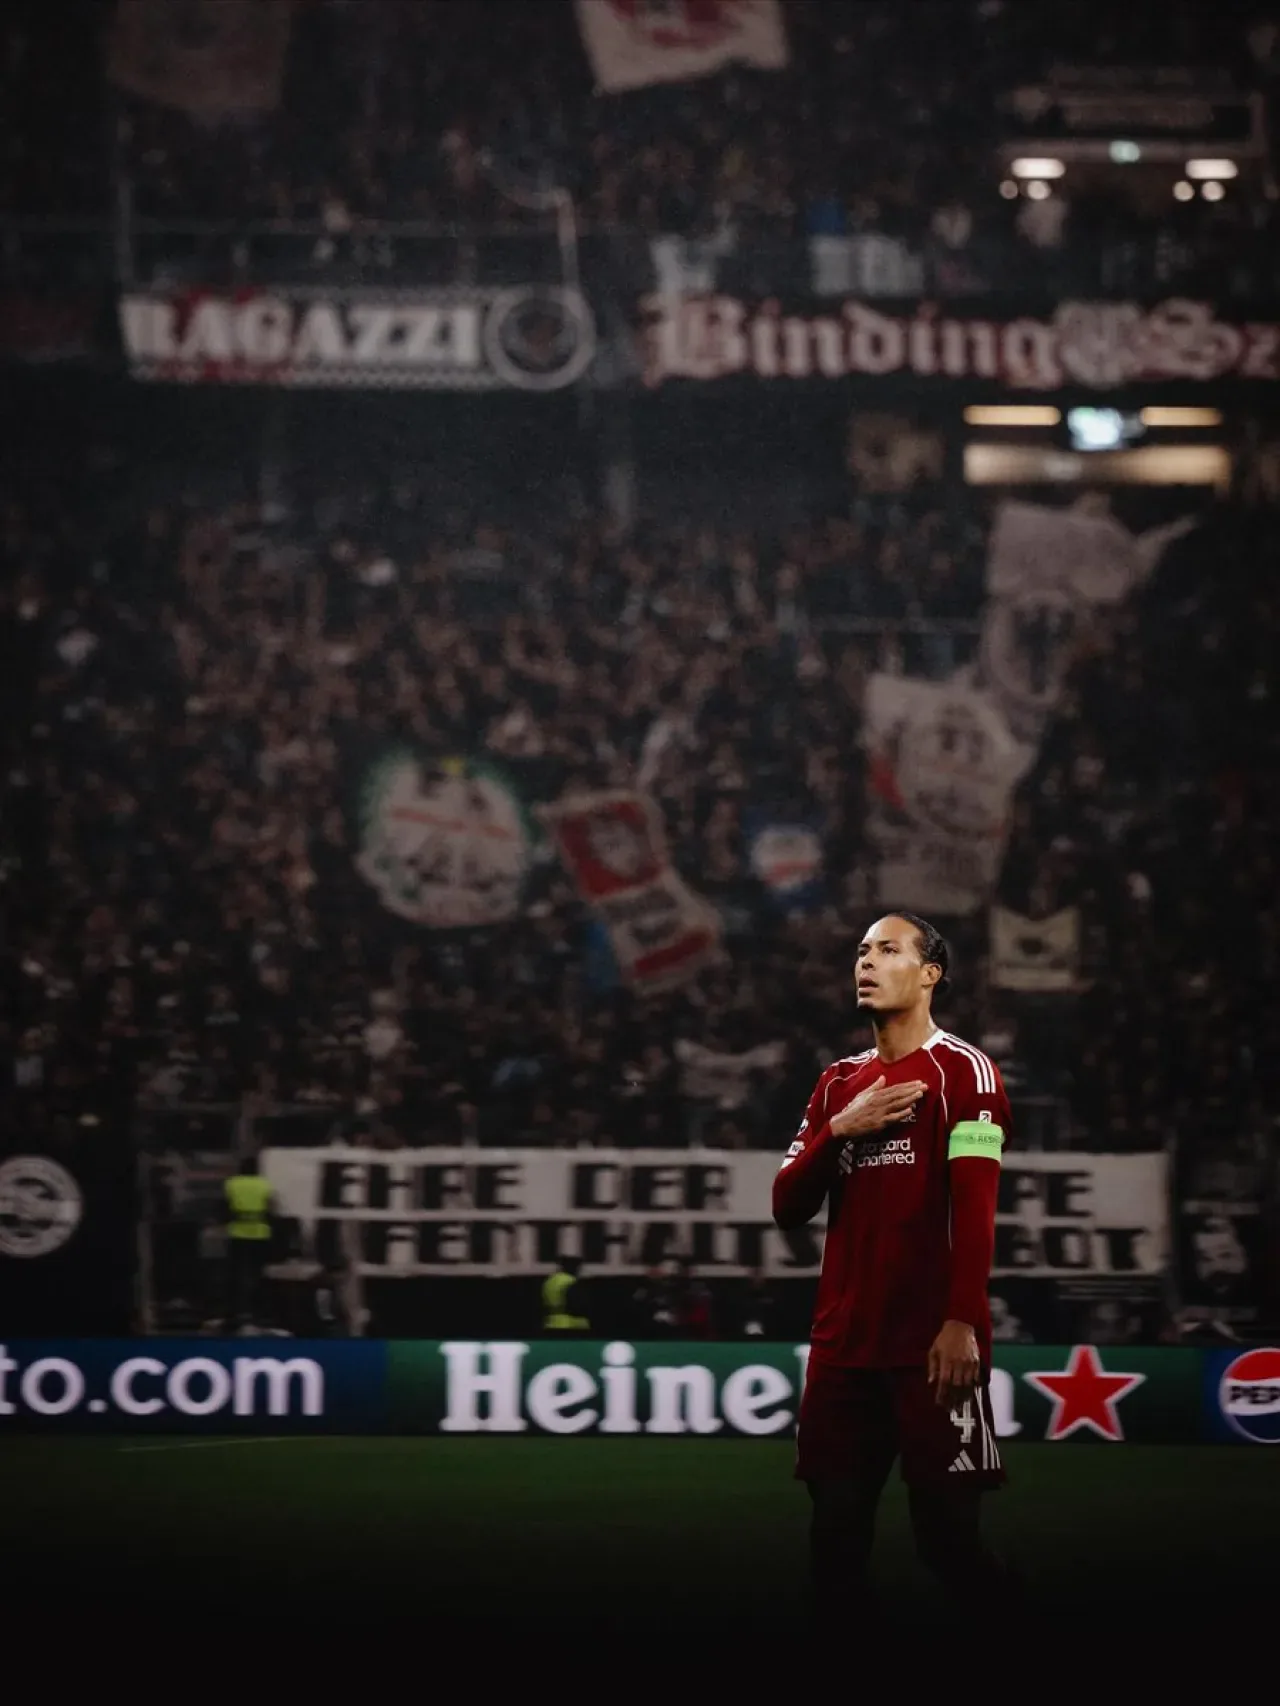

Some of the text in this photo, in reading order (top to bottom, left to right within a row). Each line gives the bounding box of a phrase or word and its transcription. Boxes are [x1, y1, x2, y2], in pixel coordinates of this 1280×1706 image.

[639, 293, 1063, 391] Binding
[857, 1151, 916, 1168] chartered
[320, 1162, 731, 1210] EHRE DER
[438, 1340, 1022, 1434] Heine
[949, 1400, 977, 1444] 4
